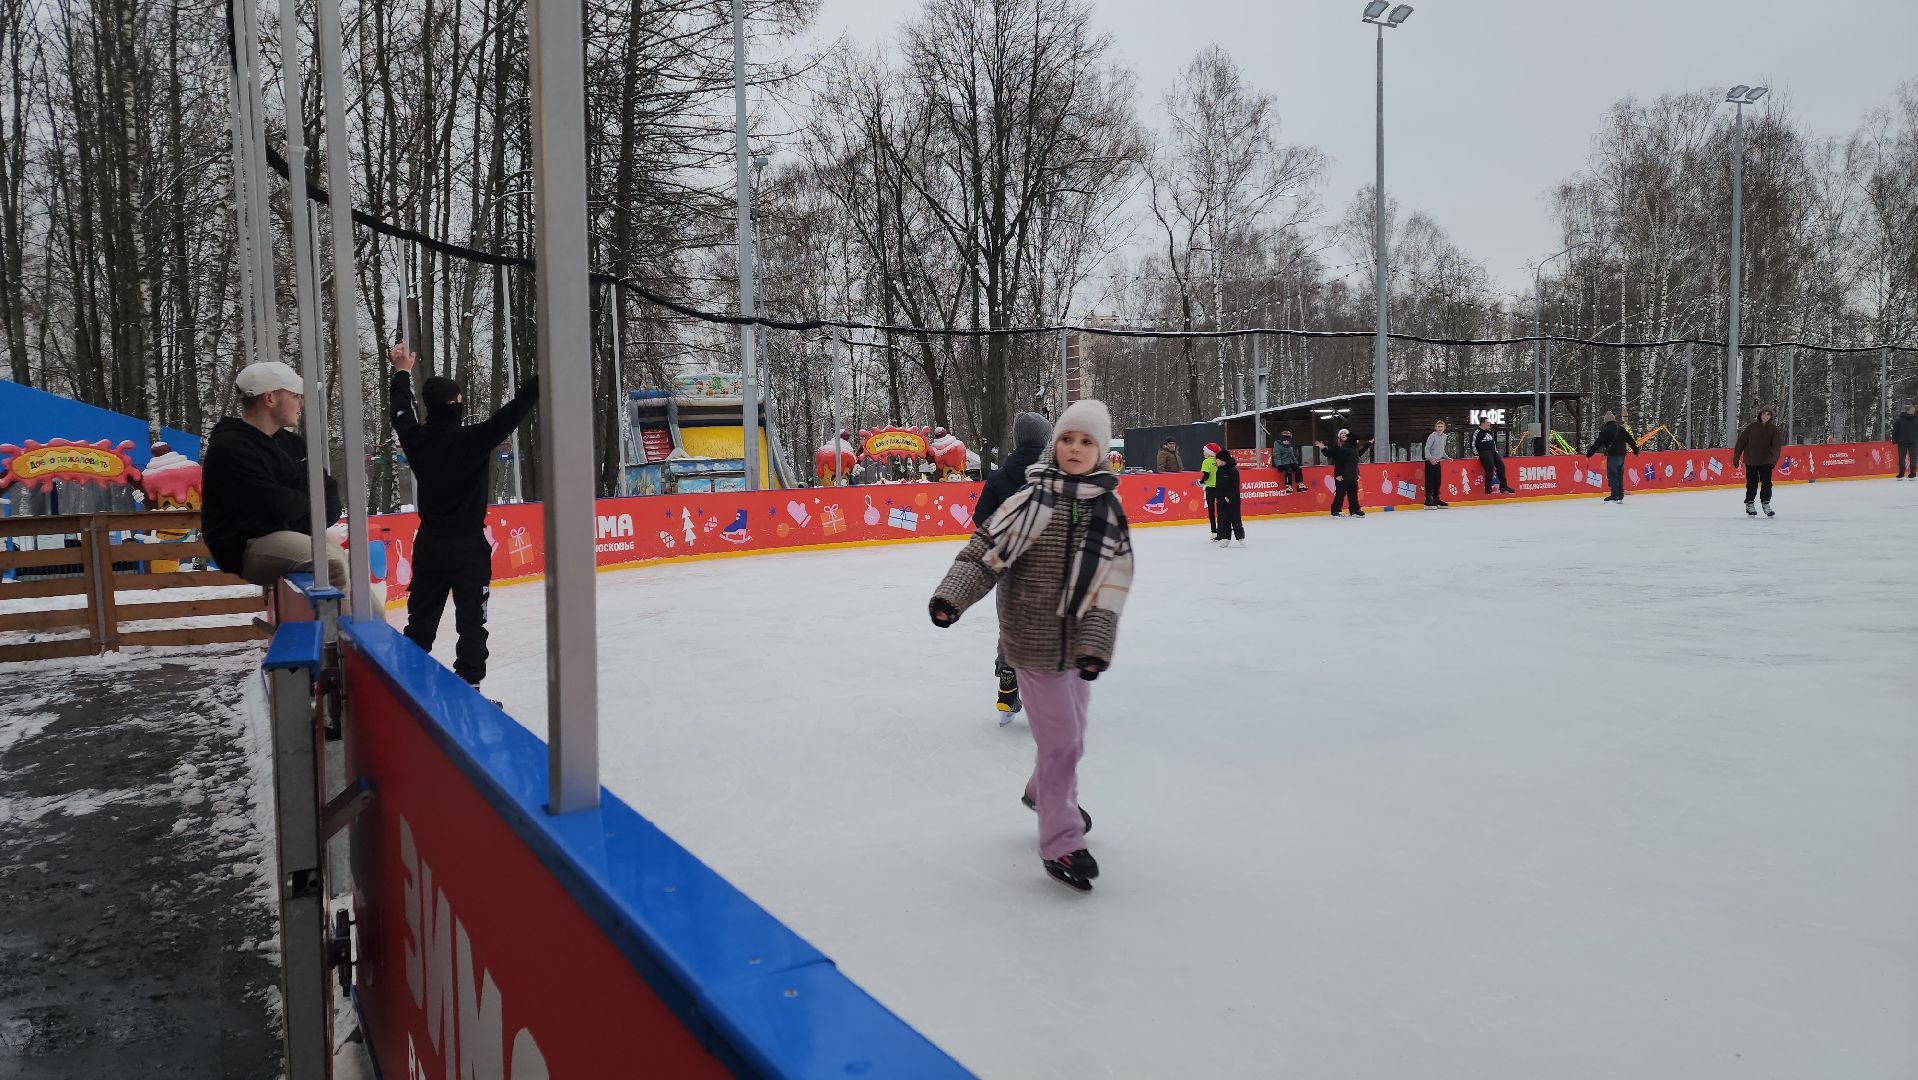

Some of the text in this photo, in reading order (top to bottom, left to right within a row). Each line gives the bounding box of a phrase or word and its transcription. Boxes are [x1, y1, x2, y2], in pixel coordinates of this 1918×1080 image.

[1519, 465, 1557, 482] ЗИМА
[1242, 480, 1279, 490] КАТАЙТЕСЬ
[1239, 489, 1288, 500] ДОВОЛЬСТВИЕ
[594, 513, 634, 539] МА
[595, 541, 635, 553] ОСКОВЬЕ
[400, 813, 550, 1080] ЗИМ
